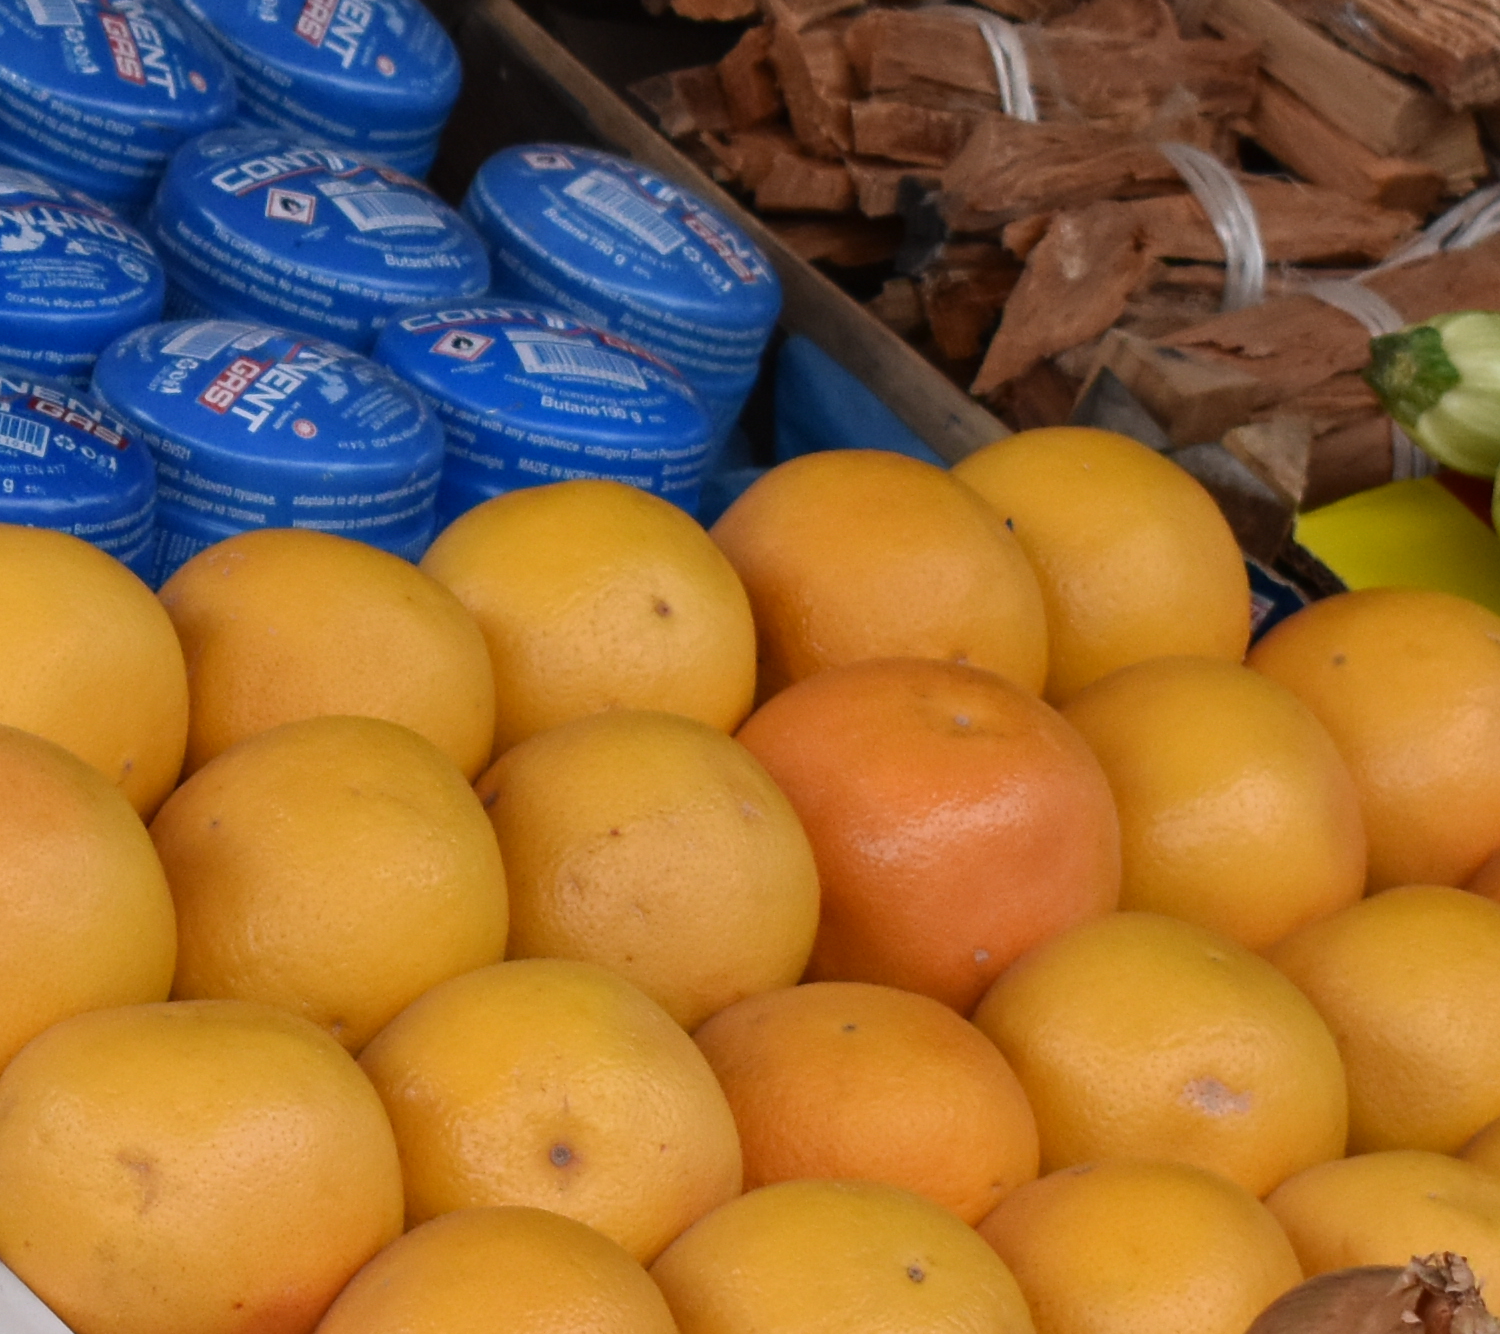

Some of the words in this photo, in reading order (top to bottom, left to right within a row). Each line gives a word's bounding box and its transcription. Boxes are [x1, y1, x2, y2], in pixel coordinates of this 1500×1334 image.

[103, 15, 146, 84] GAS
[203, 359, 262, 411] GAS
[36, 399, 124, 446] GAS
[540, 394, 599, 417] Butane
[599, 404, 627, 420] 190
[2, 478, 15, 493] g
[518, 458, 550, 479] MADE
